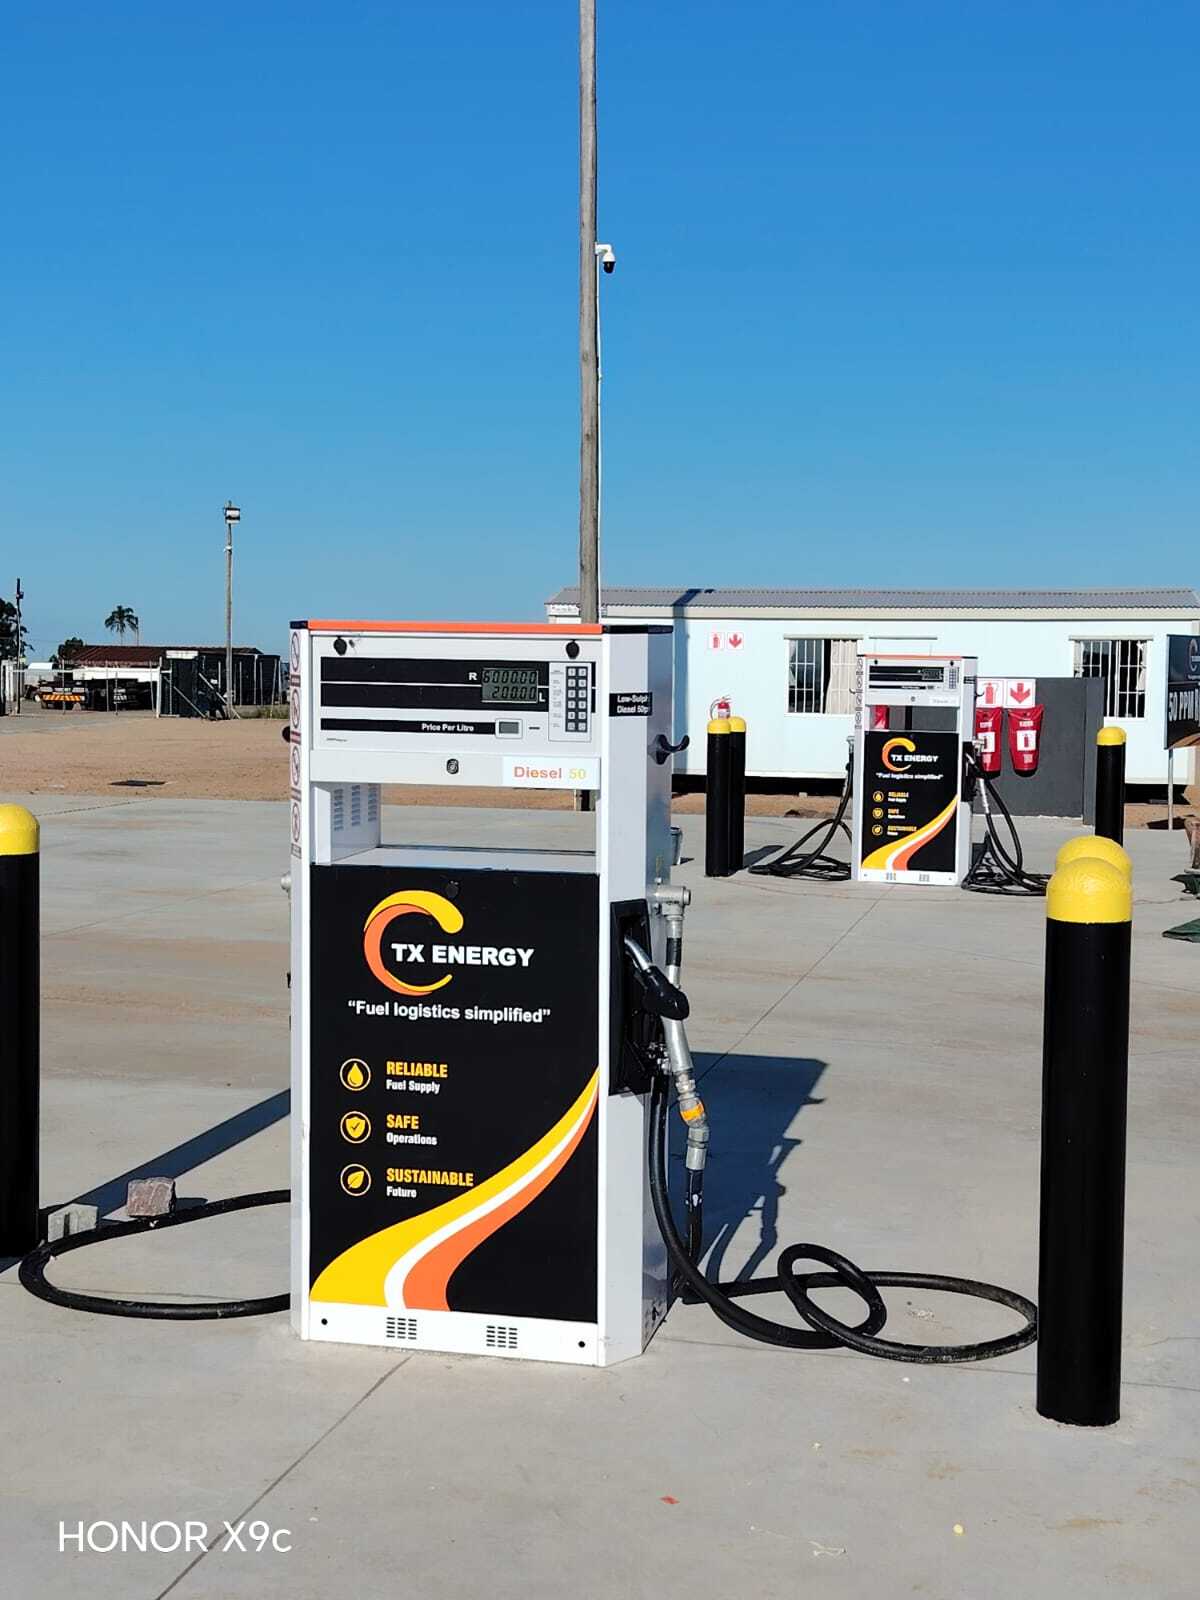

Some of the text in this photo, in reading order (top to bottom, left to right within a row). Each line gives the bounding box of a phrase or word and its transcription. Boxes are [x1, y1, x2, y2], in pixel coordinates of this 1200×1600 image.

[468, 672, 477, 681] R
[539, 692, 547, 702] L
[421, 722, 441, 732] Price
[442, 723, 456, 732] Per
[890, 754, 939, 762] TX ENERGY
[513, 766, 587, 780] Diesel 50
[391, 943, 535, 967] TX ENERGY
[347, 1000, 551, 1025] “Fuel logistics simplified”
[386, 1061, 448, 1078] RELIABLE
[386, 1079, 441, 1094] Fuel Supply
[386, 1114, 419, 1130] SAFE
[386, 1132, 438, 1145] Operations
[386, 1167, 474, 1187] SUSTAINABLE
[386, 1186, 417, 1198] Future
